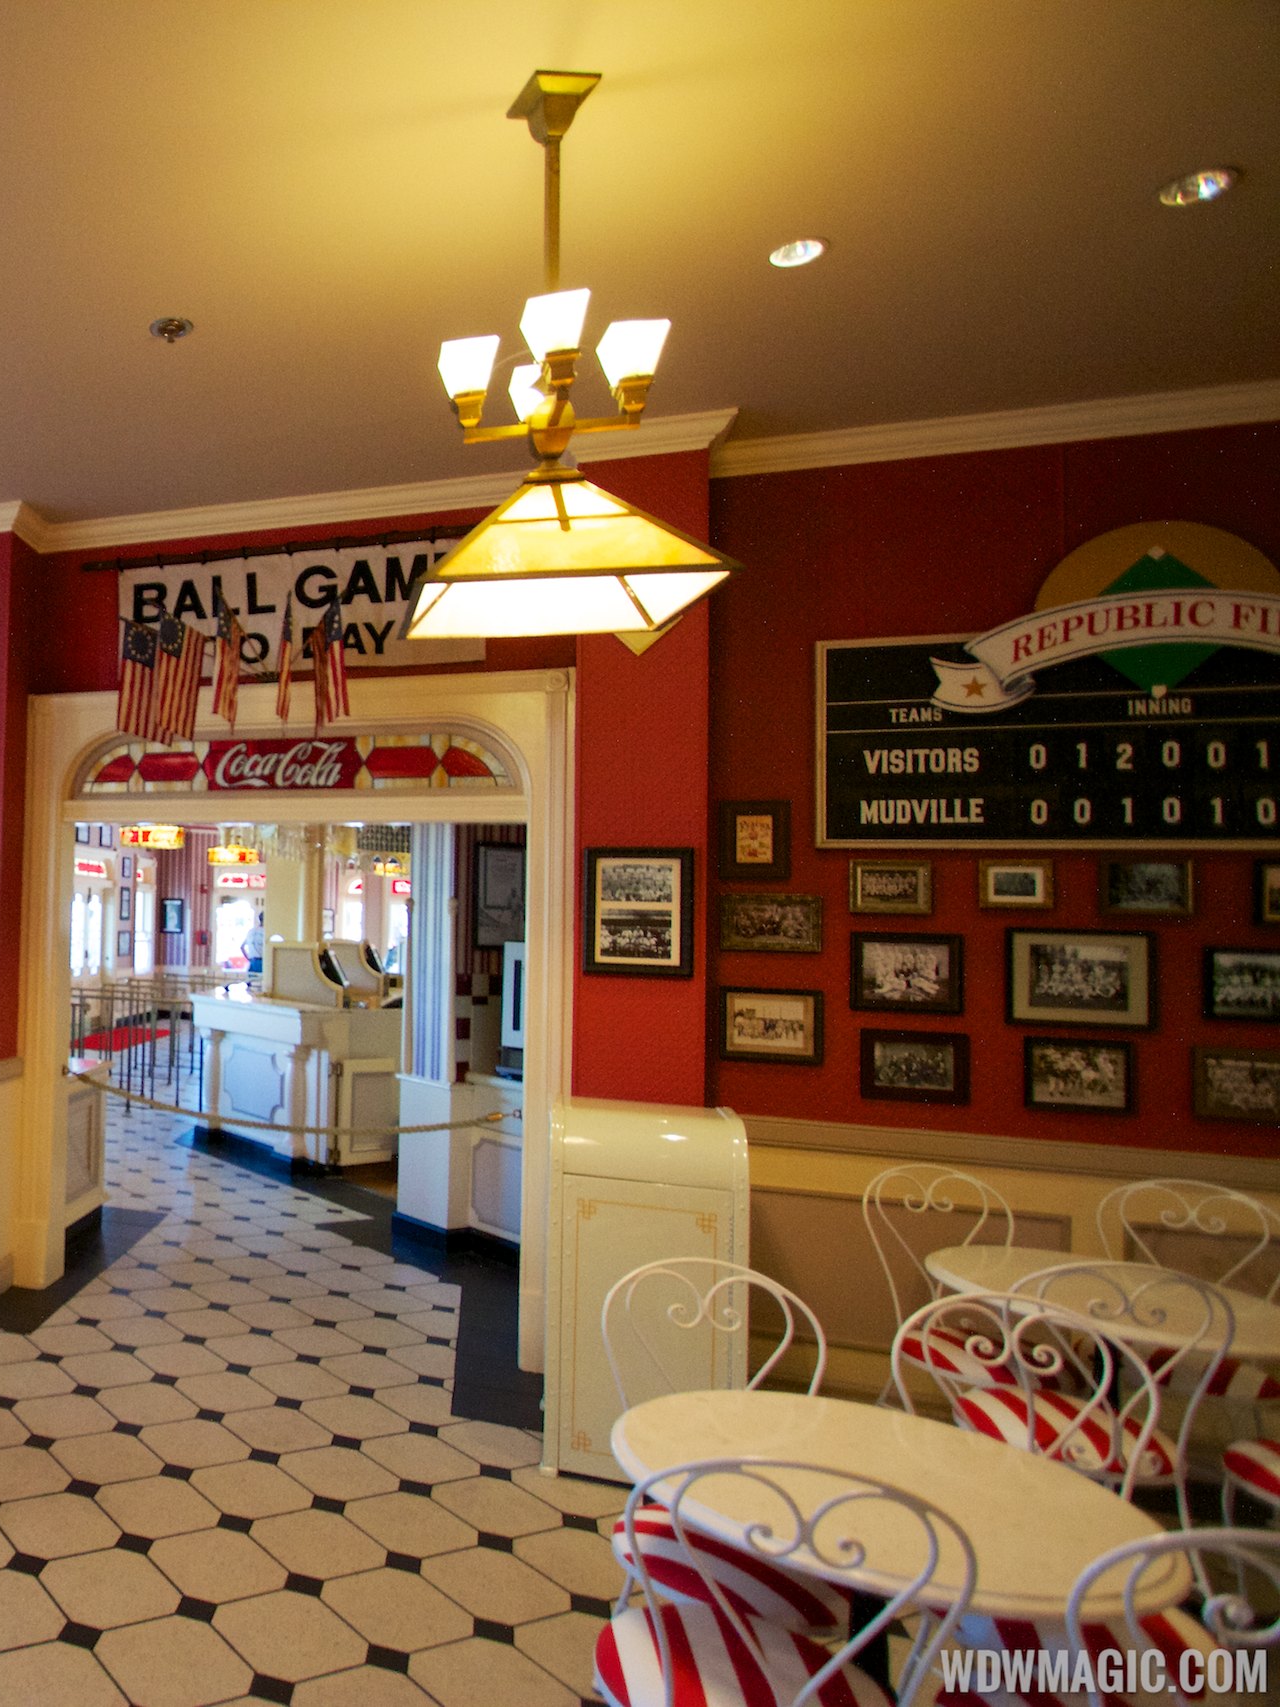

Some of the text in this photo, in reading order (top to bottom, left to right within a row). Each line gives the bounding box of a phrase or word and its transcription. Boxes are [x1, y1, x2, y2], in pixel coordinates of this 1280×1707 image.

[133, 552, 448, 624] BALL GAM
[1011, 600, 1280, 664] REPUBLIC FI
[889, 707, 943, 723] TEAMS
[1127, 697, 1193, 716] INNING
[215, 741, 348, 788] Coca-Cola
[862, 740, 1269, 775] VISITORS 0 1 2 0 0 1
[859, 796, 1277, 826] MUDVILLE 0 0 1 0 1 0
